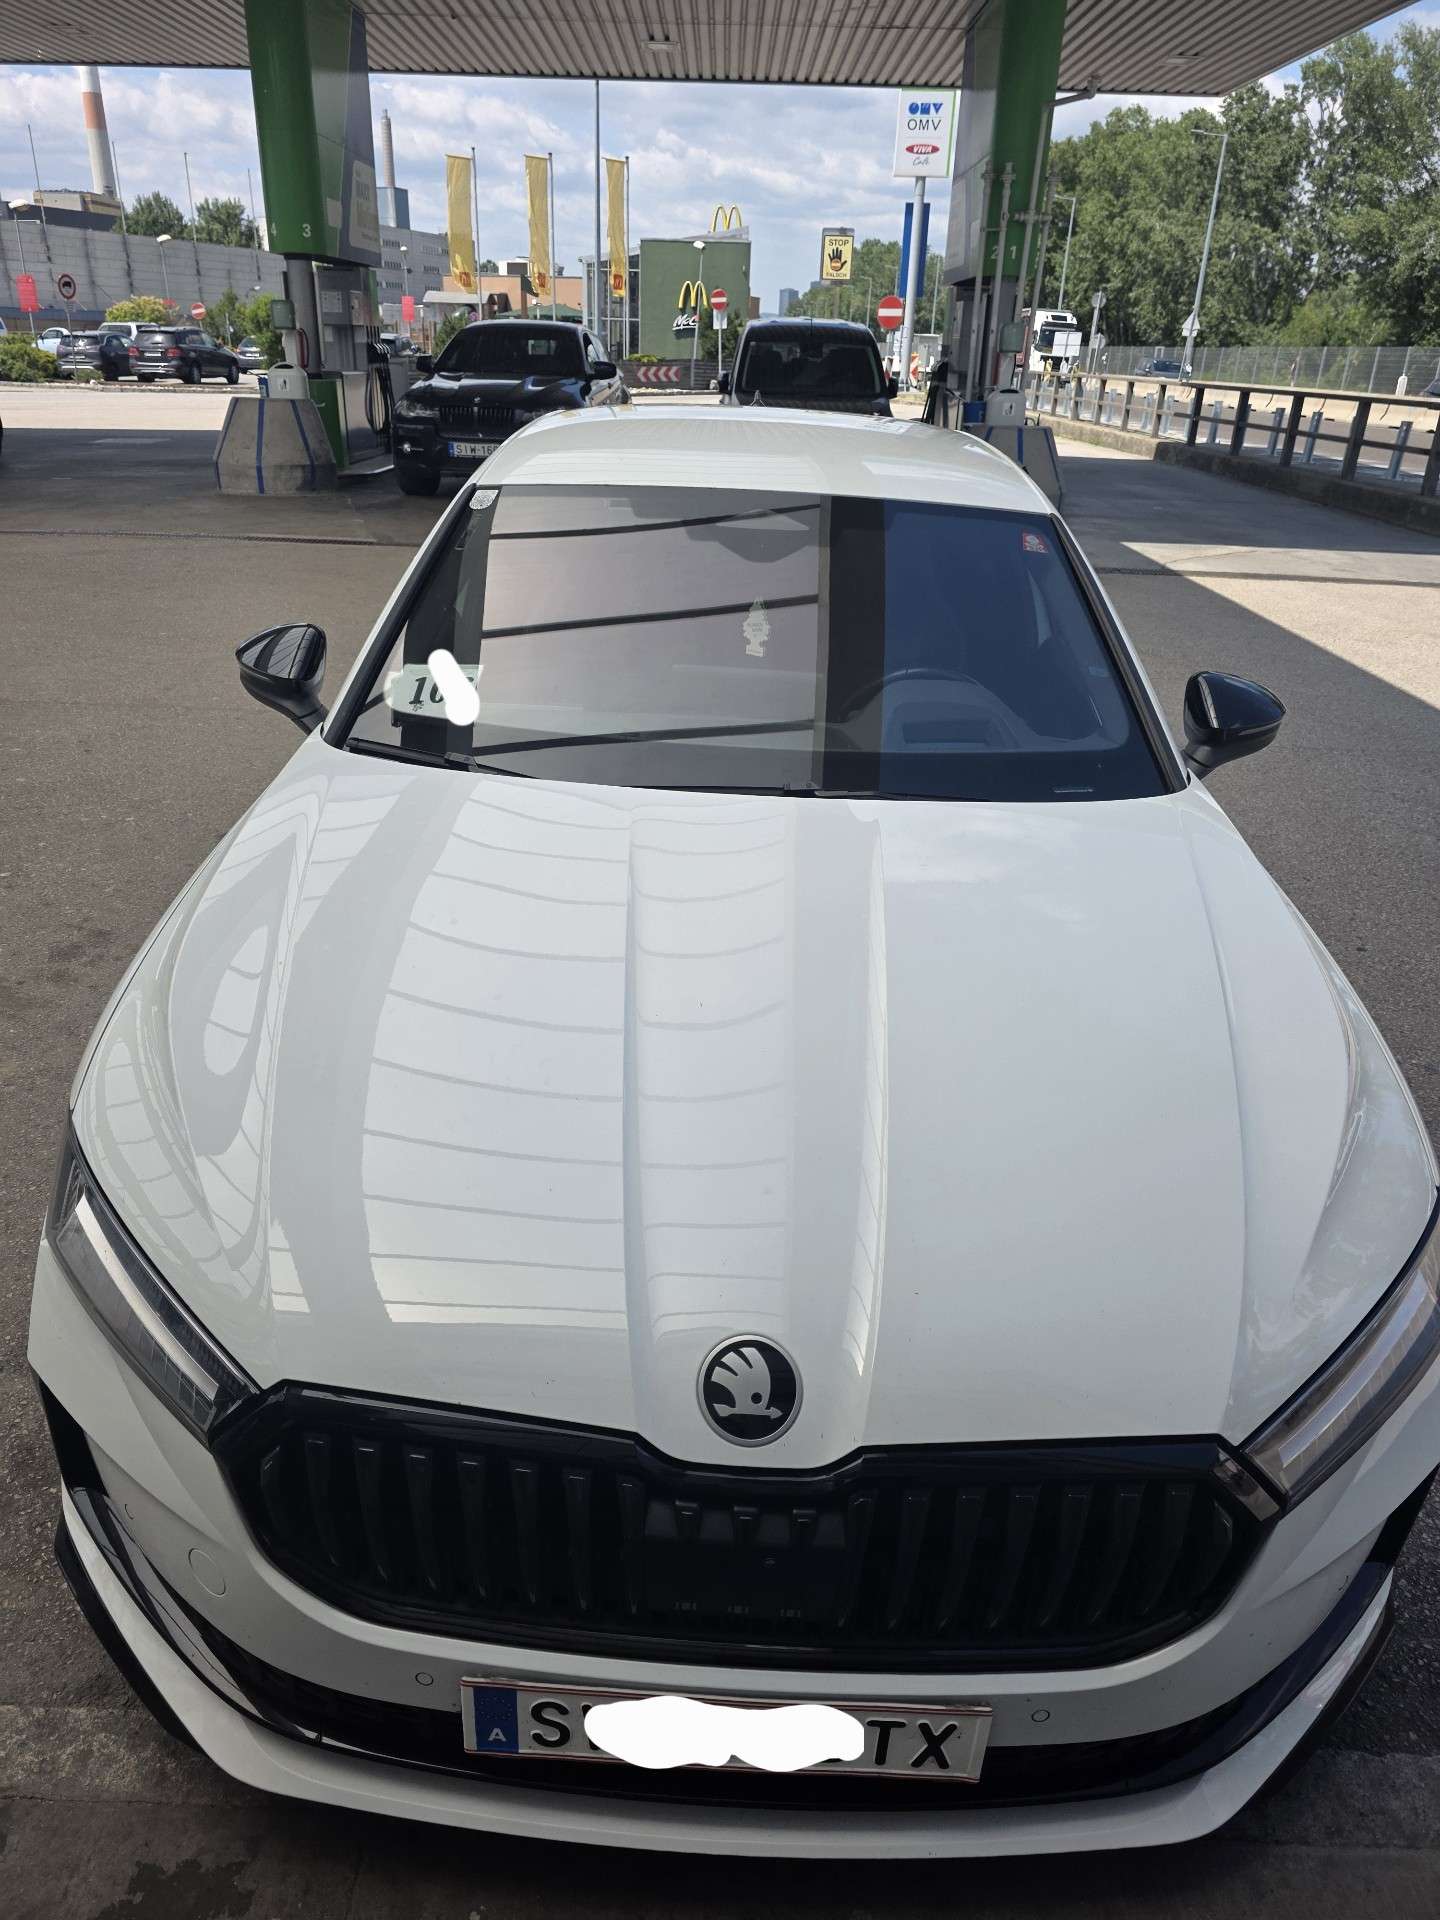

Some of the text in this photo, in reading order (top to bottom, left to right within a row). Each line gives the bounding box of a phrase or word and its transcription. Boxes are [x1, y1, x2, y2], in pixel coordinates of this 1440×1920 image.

[907, 118, 942, 131] OMV
[912, 144, 933, 153] VIVA
[302, 223, 312, 238] 3
[828, 239, 850, 247] STOP
[1010, 246, 1017, 259] 1
[487, 1727, 507, 1742] A
